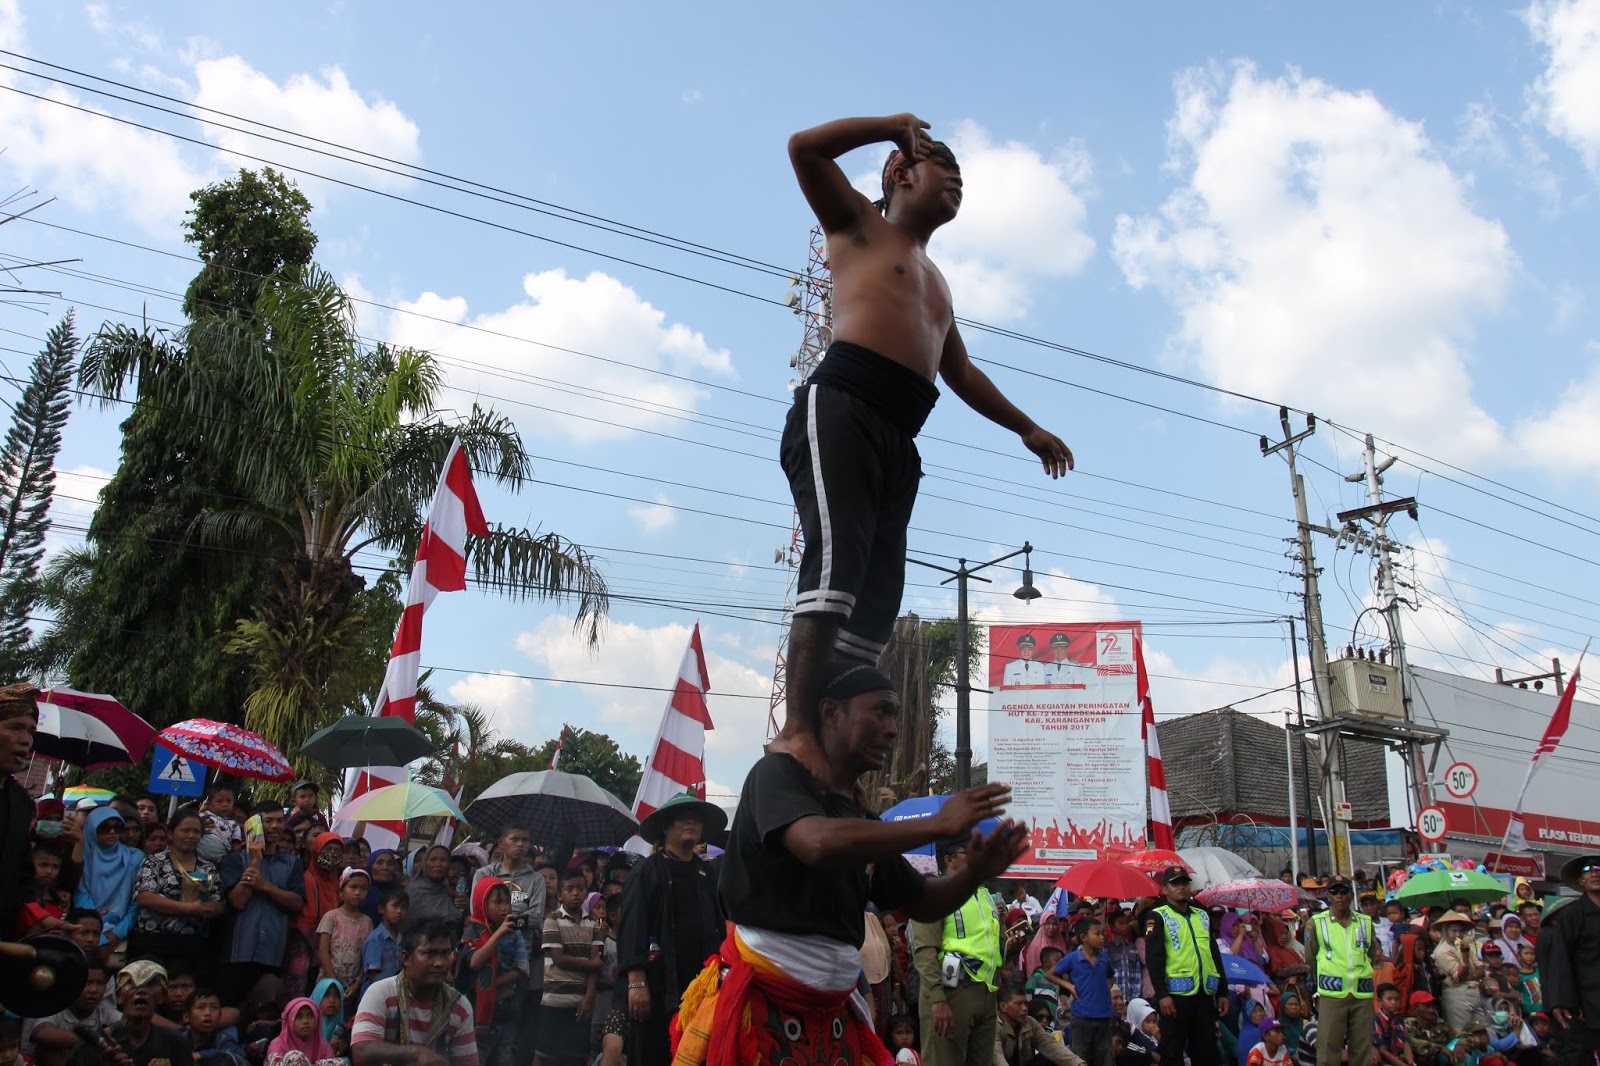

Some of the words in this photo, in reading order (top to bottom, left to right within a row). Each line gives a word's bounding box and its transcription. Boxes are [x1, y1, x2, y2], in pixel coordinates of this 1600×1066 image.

[1101, 632, 1121, 655] 72
[1452, 771, 1465, 790] 50
[1423, 815, 1436, 833] 50
[1538, 828, 1568, 841] PLASA
[1507, 864, 1531, 873] CORNER
